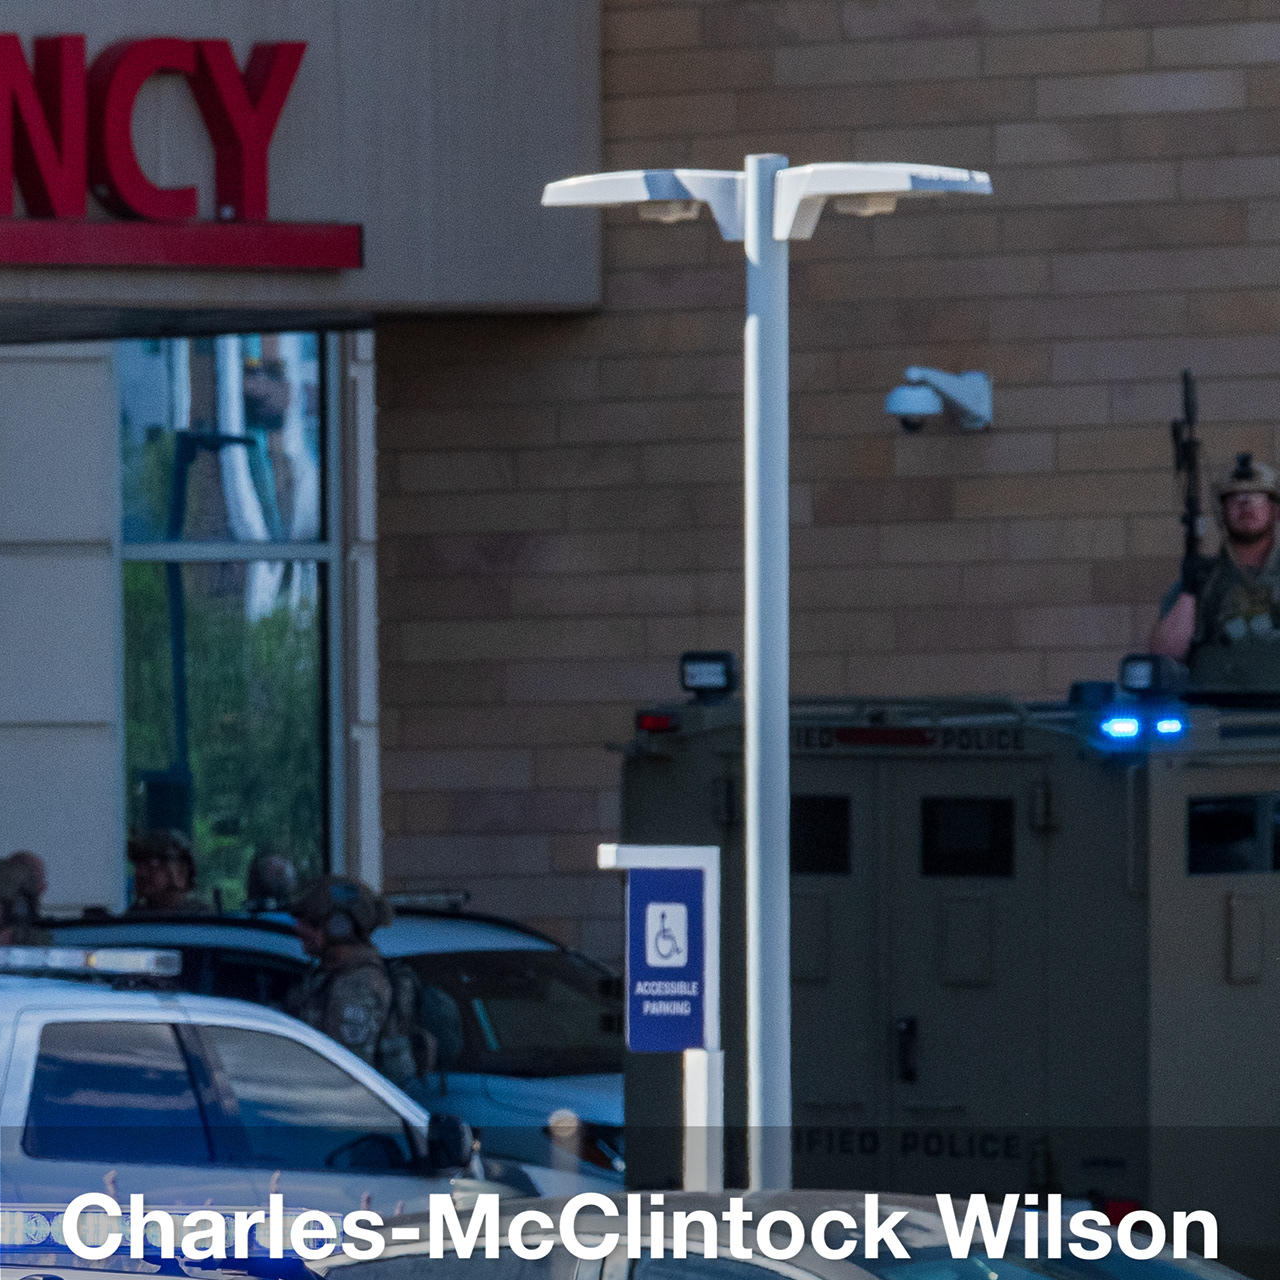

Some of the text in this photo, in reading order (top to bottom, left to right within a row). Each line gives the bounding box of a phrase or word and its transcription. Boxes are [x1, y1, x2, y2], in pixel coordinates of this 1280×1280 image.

[634, 981, 699, 997] ACCESSIBLE
[643, 1000, 692, 1017] PARKING
[901, 1131, 1021, 1158] POLICE
